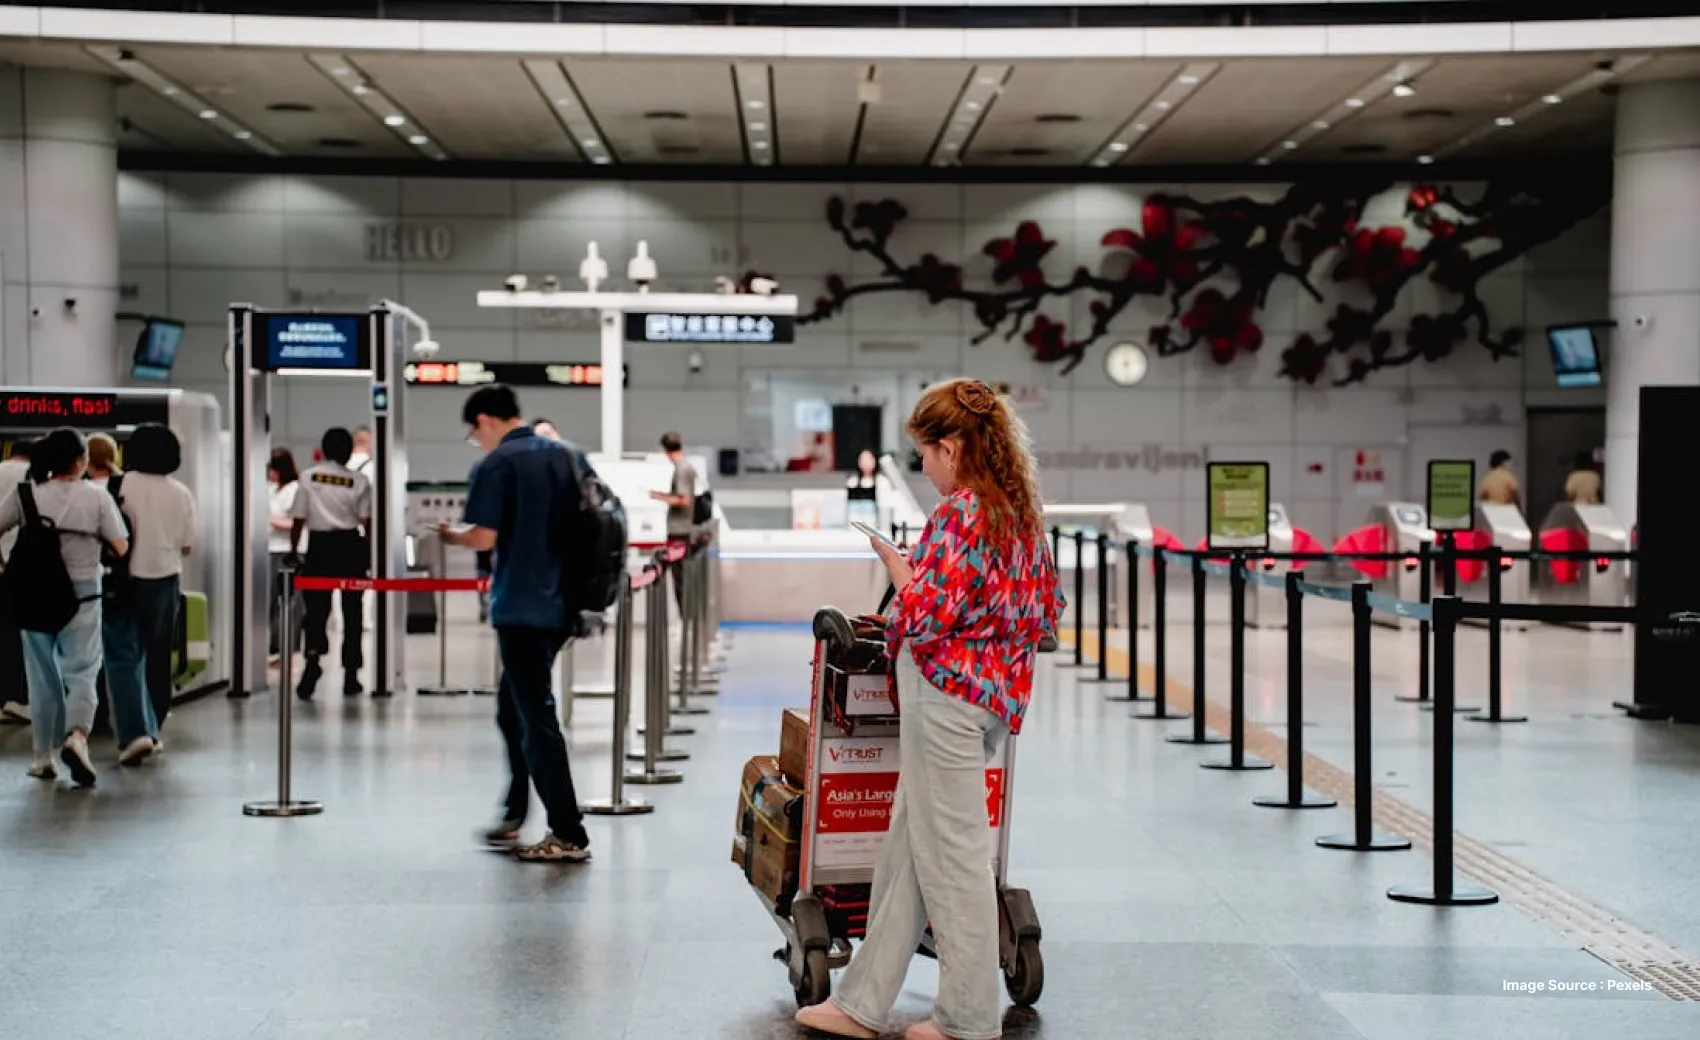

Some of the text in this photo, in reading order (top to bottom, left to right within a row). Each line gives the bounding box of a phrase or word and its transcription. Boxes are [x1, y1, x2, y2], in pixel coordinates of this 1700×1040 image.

[365, 223, 453, 261] HELLO
[827, 788, 862, 802] Asia's
[833, 808, 857, 820] Only
[859, 808, 887, 818] Using
